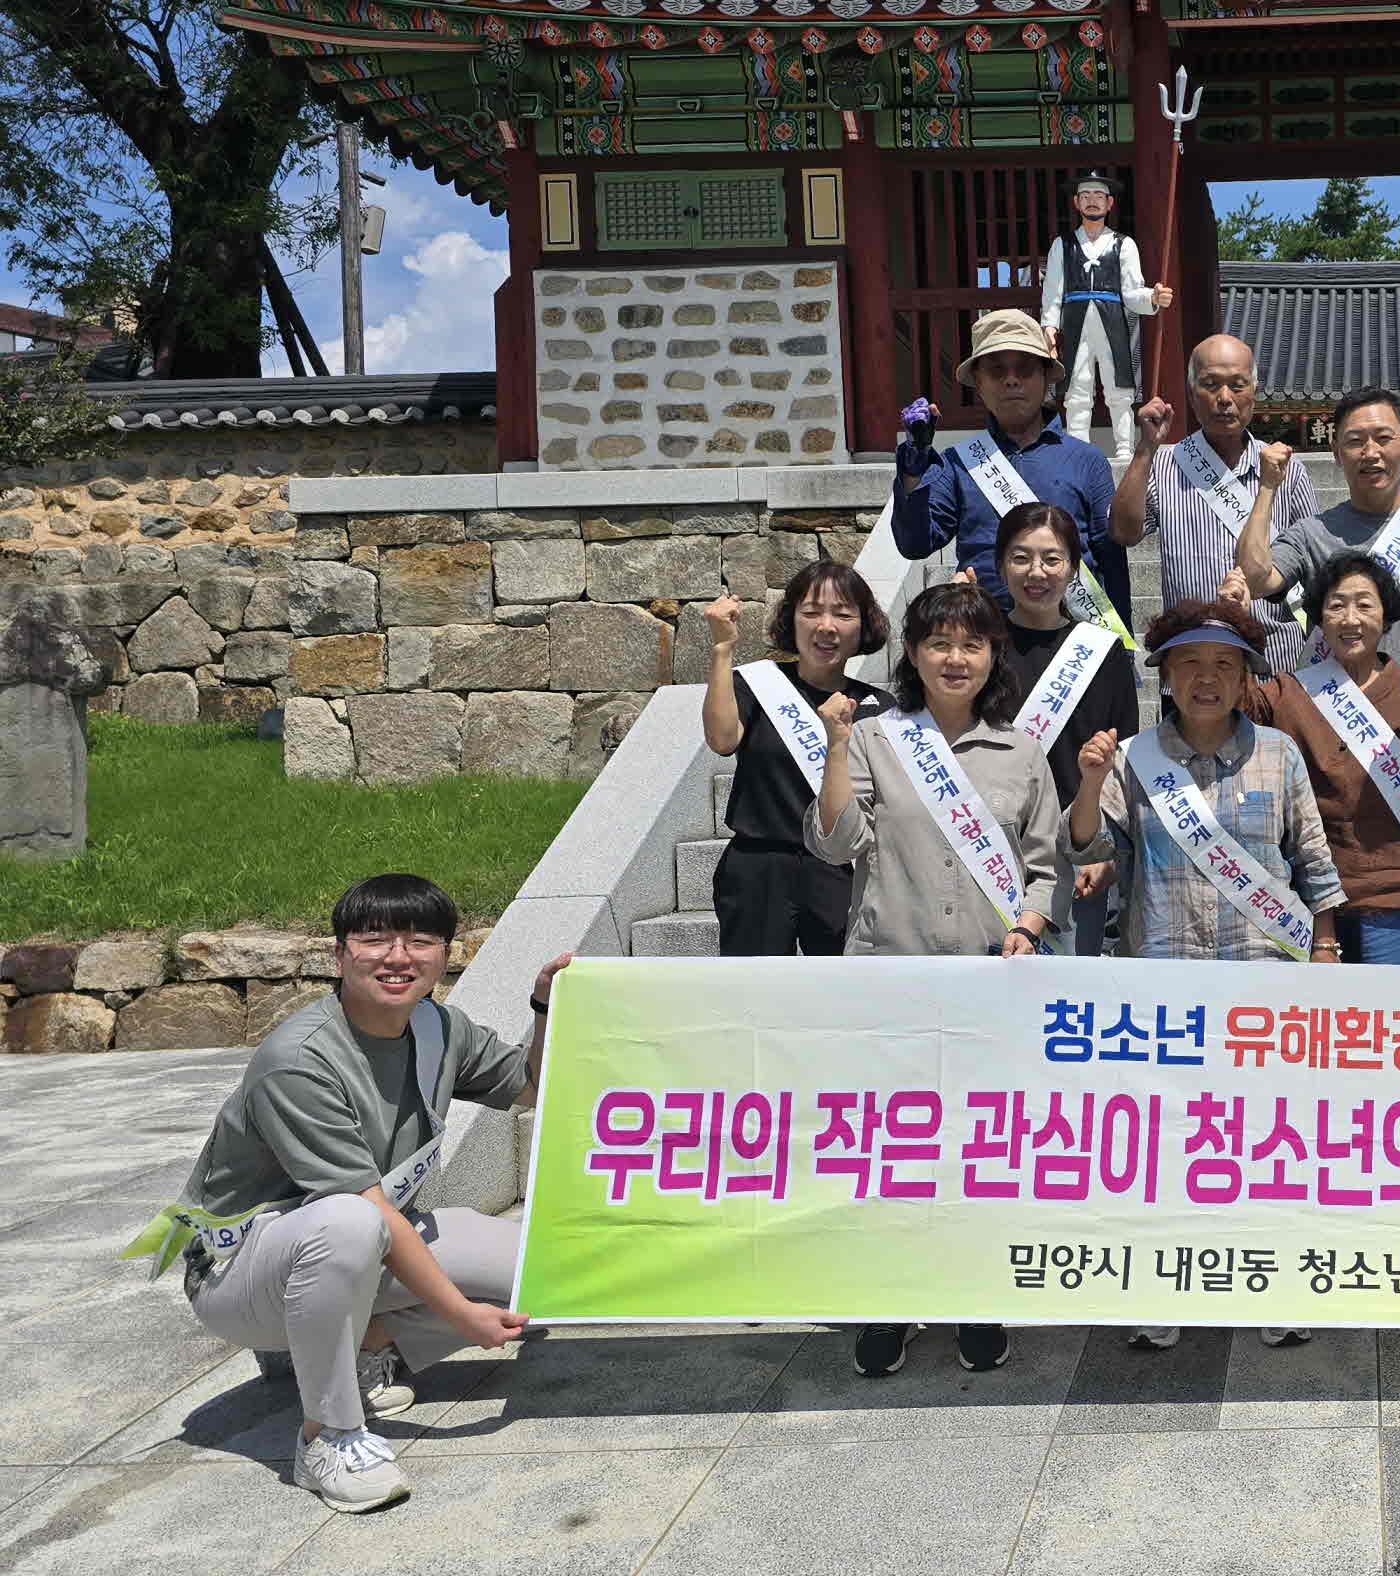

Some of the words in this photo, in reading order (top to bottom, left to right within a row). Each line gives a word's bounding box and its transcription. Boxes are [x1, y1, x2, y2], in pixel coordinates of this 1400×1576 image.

[1041, 643, 1094, 714] 청소년에게
[1319, 678, 1379, 743] 청소년에게
[777, 702, 828, 778] 청소년에
[901, 723, 960, 801] 청소년에게
[950, 802, 992, 853] 사랑과
[982, 852, 1017, 903] 관심을
[1153, 771, 1213, 846] 청소년에게
[1207, 845, 1252, 891] 사랑과
[1249, 887, 1294, 928] 관심을
[1043, 999, 1205, 1065] 청소년
[590, 1091, 792, 1200] 우리의
[814, 1090, 943, 1199] 작은
[961, 1091, 1161, 1203] 관심이
[1009, 1243, 1132, 1291] 밀양시
[1154, 1247, 1279, 1293] 내일동
